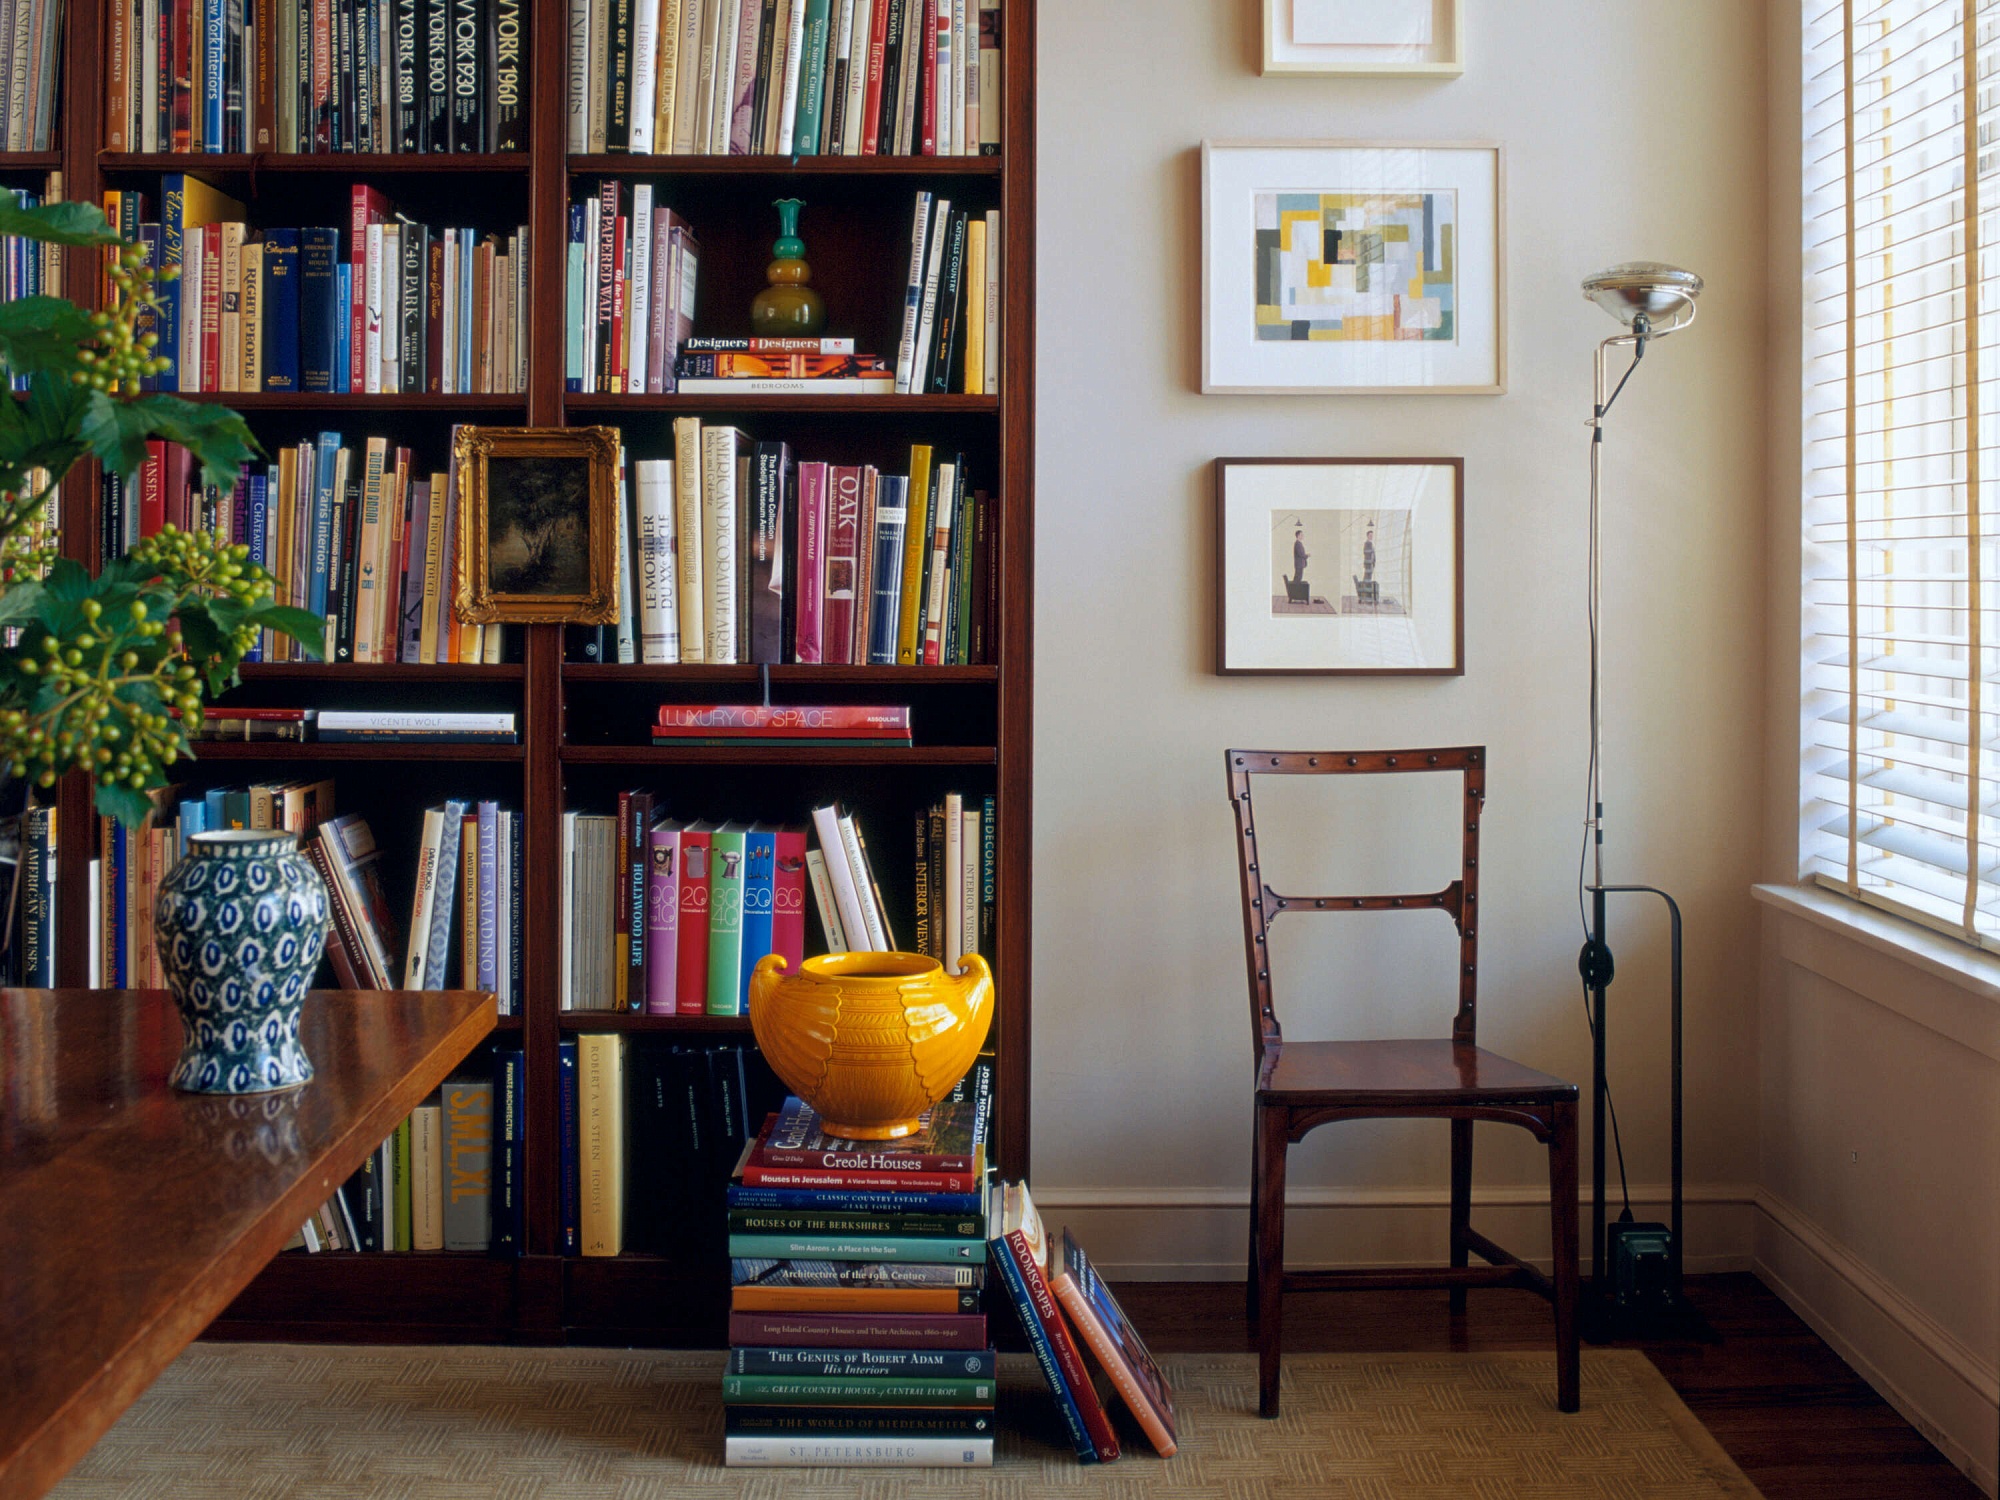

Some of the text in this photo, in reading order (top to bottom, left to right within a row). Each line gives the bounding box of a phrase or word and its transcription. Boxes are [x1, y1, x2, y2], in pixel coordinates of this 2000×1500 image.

[113, 20, 122, 82] APARTMENTS
[208, 17, 220, 100] York Interiors
[300, 9, 309, 83] GRAMERCY PARK
[316, 26, 327, 101] APARTMENTS
[357, 7, 369, 125] MANSIONS IN THE CLOUDS
[399, 12, 414, 103] YORK 1880
[429, 10, 445, 92] YORK 1900
[456, 13, 475, 95] YORK 1930
[498, 10, 519, 105] YORK 1960
[570, 9, 586, 115] INTERIORS
[636, 24, 649, 86] LIBRARIES
[870, 43, 882, 81] Interiors
[968, 36, 977, 95] Color Palettes
[11, 56, 29, 119] HOUSES
[615, 29, 626, 126] OF THE GREAT
[226, 236, 237, 287] SISTER
[599, 181, 615, 324] THE PAPERED WALL
[634, 210, 647, 313] THE PAPERED WALL
[656, 244, 664, 299] MODERNIST
[949, 220, 962, 293] CATSKILLS COUNTRY
[405, 242, 419, 318] 740 PARK
[988, 282, 997, 323] Bedrooms
[244, 268, 256, 379] RIGHT PEOPLE
[654, 303, 663, 338] TEXTILE
[923, 301, 935, 325] BED
[688, 338, 819, 351] Designers Designers
[146, 454, 158, 501] JANSEN
[758, 454, 767, 486] Stedelijk
[768, 470, 776, 502] Furniture
[681, 432, 696, 584] WORLD FURNITURE
[768, 503, 776, 539] Collection
[839, 476, 857, 530] OAK
[316, 488, 332, 574] Paris Interiors
[332, 506, 341, 555] UNDERGROUND
[716, 430, 730, 660] AMERICAN DECORATIVE ARTS
[759, 518, 767, 561] Amsterdam
[807, 510, 815, 560] CHIPPENDALE
[370, 717, 413, 726] VICENTE
[415, 718, 443, 727] WOLF
[666, 709, 833, 728] LUXURY OF SPACE
[424, 848, 436, 890] DAVID HICKS
[466, 852, 474, 903] DAVID HICKS
[984, 800, 995, 903] THE DECORATOR
[26, 845, 39, 971] AMERICAN HOUSES
[481, 824, 494, 972] STYLE BY SALADINO
[916, 862, 927, 916] INTERIOR
[966, 863, 974, 911] INTERIOR
[632, 863, 643, 966] HOLLYWOOD LIFE
[591, 1046, 600, 1089] ROBERT
[980, 1066, 990, 1096] JOSEF
[505, 1089, 513, 1141] ARCHITECTURE
[592, 1125, 601, 1161] STERN
[822, 1153, 922, 1170] Creole Houses
[592, 1169, 601, 1215] HOUSES
[761, 1175, 843, 1184] Houses in Jerusalem
[745, 1219, 890, 1231] HOUSES OF THE BERKSHIRES
[790, 1244, 830, 1252] Slim Aarons
[782, 1270, 838, 1280] Architecture
[840, 1270, 851, 1279] of
[852, 1271, 867, 1280] the
[891, 1272, 926, 1282] Century
[1011, 1232, 1055, 1320] ROOMSCAPES
[823, 1364, 890, 1375] His Interiors
[1019, 1301, 1063, 1396] interior inspirations
[814, 1447, 916, 1458] PETERSBURG
